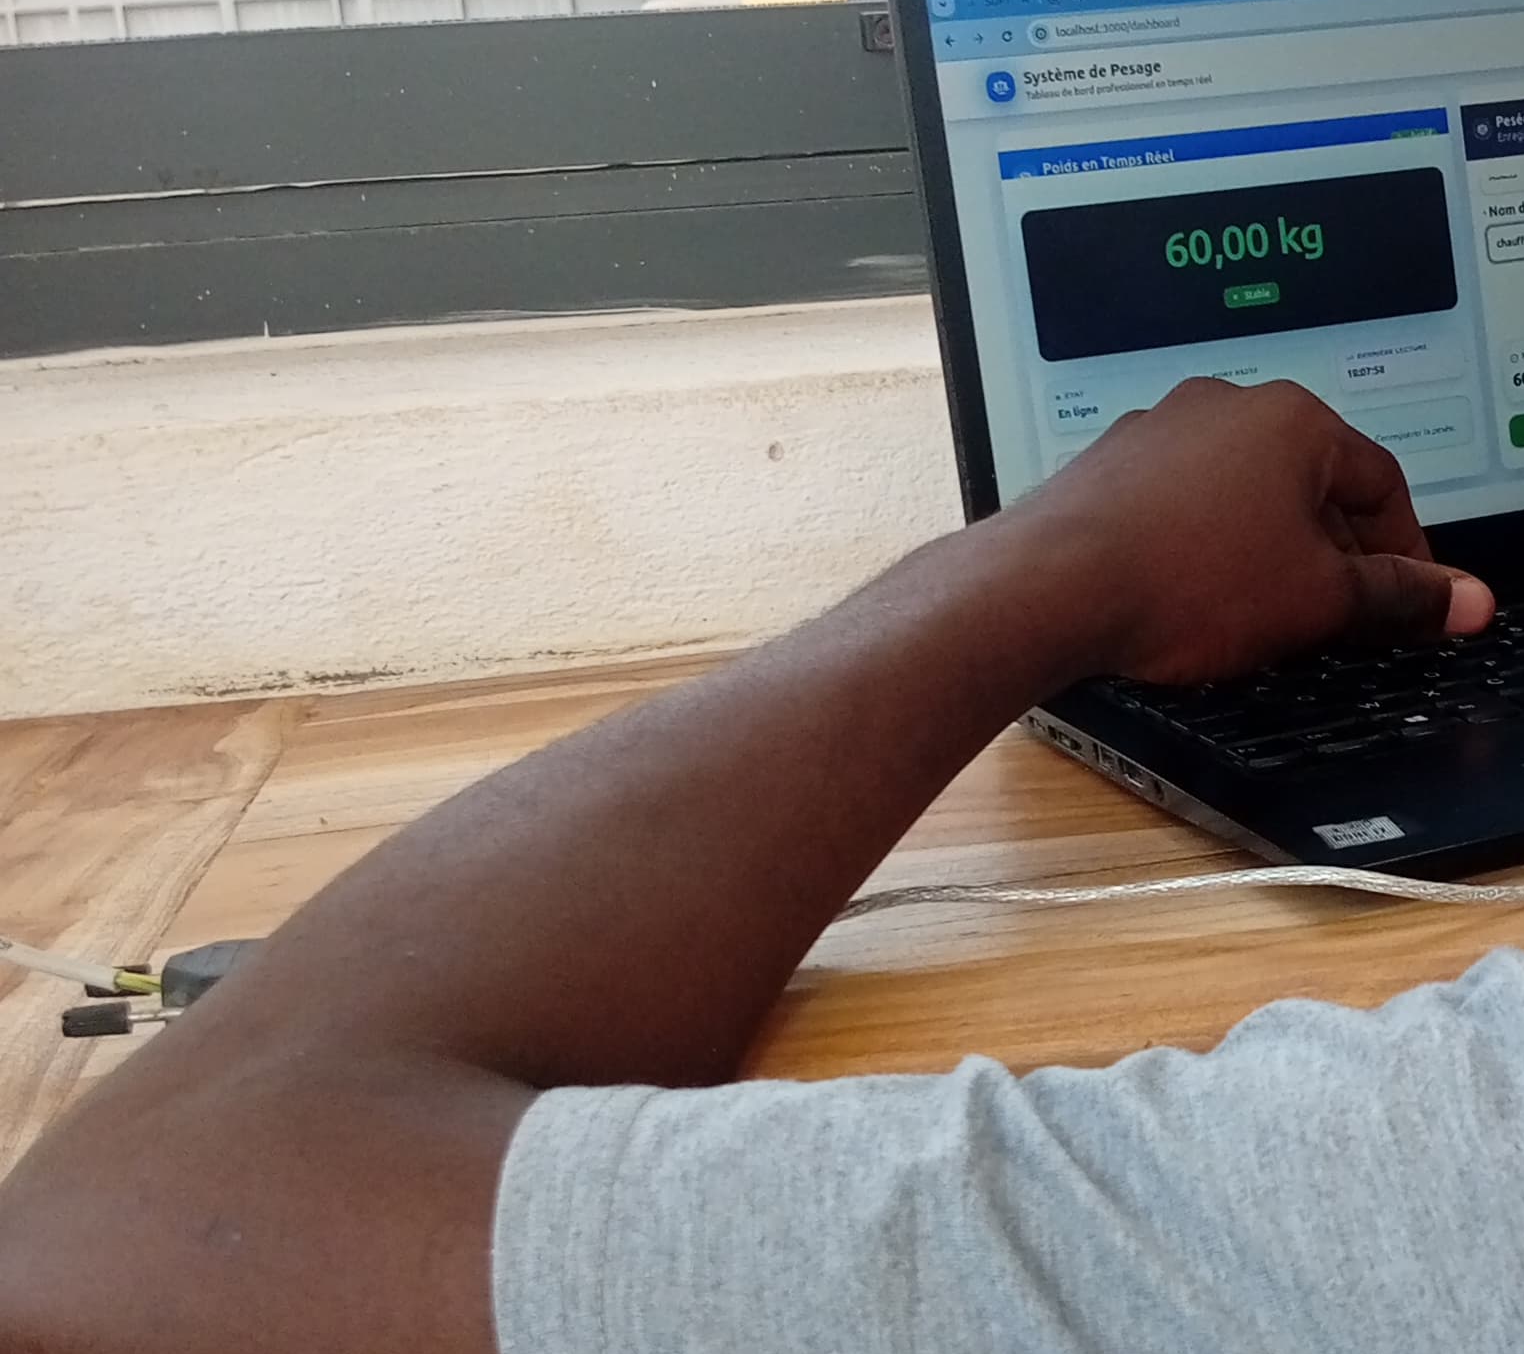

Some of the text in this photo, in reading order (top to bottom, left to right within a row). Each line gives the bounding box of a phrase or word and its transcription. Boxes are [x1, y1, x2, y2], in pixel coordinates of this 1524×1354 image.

[1023, 61, 1162, 86] Système de Pesage
[1061, 86, 1072, 98] de
[1073, 84, 1095, 97] bord
[1042, 148, 1176, 176] Poids en Temps Réel
[1488, 204, 1517, 218] Nom
[1165, 215, 1325, 270] 60,00 kg
[1058, 404, 1099, 420] En ligne
